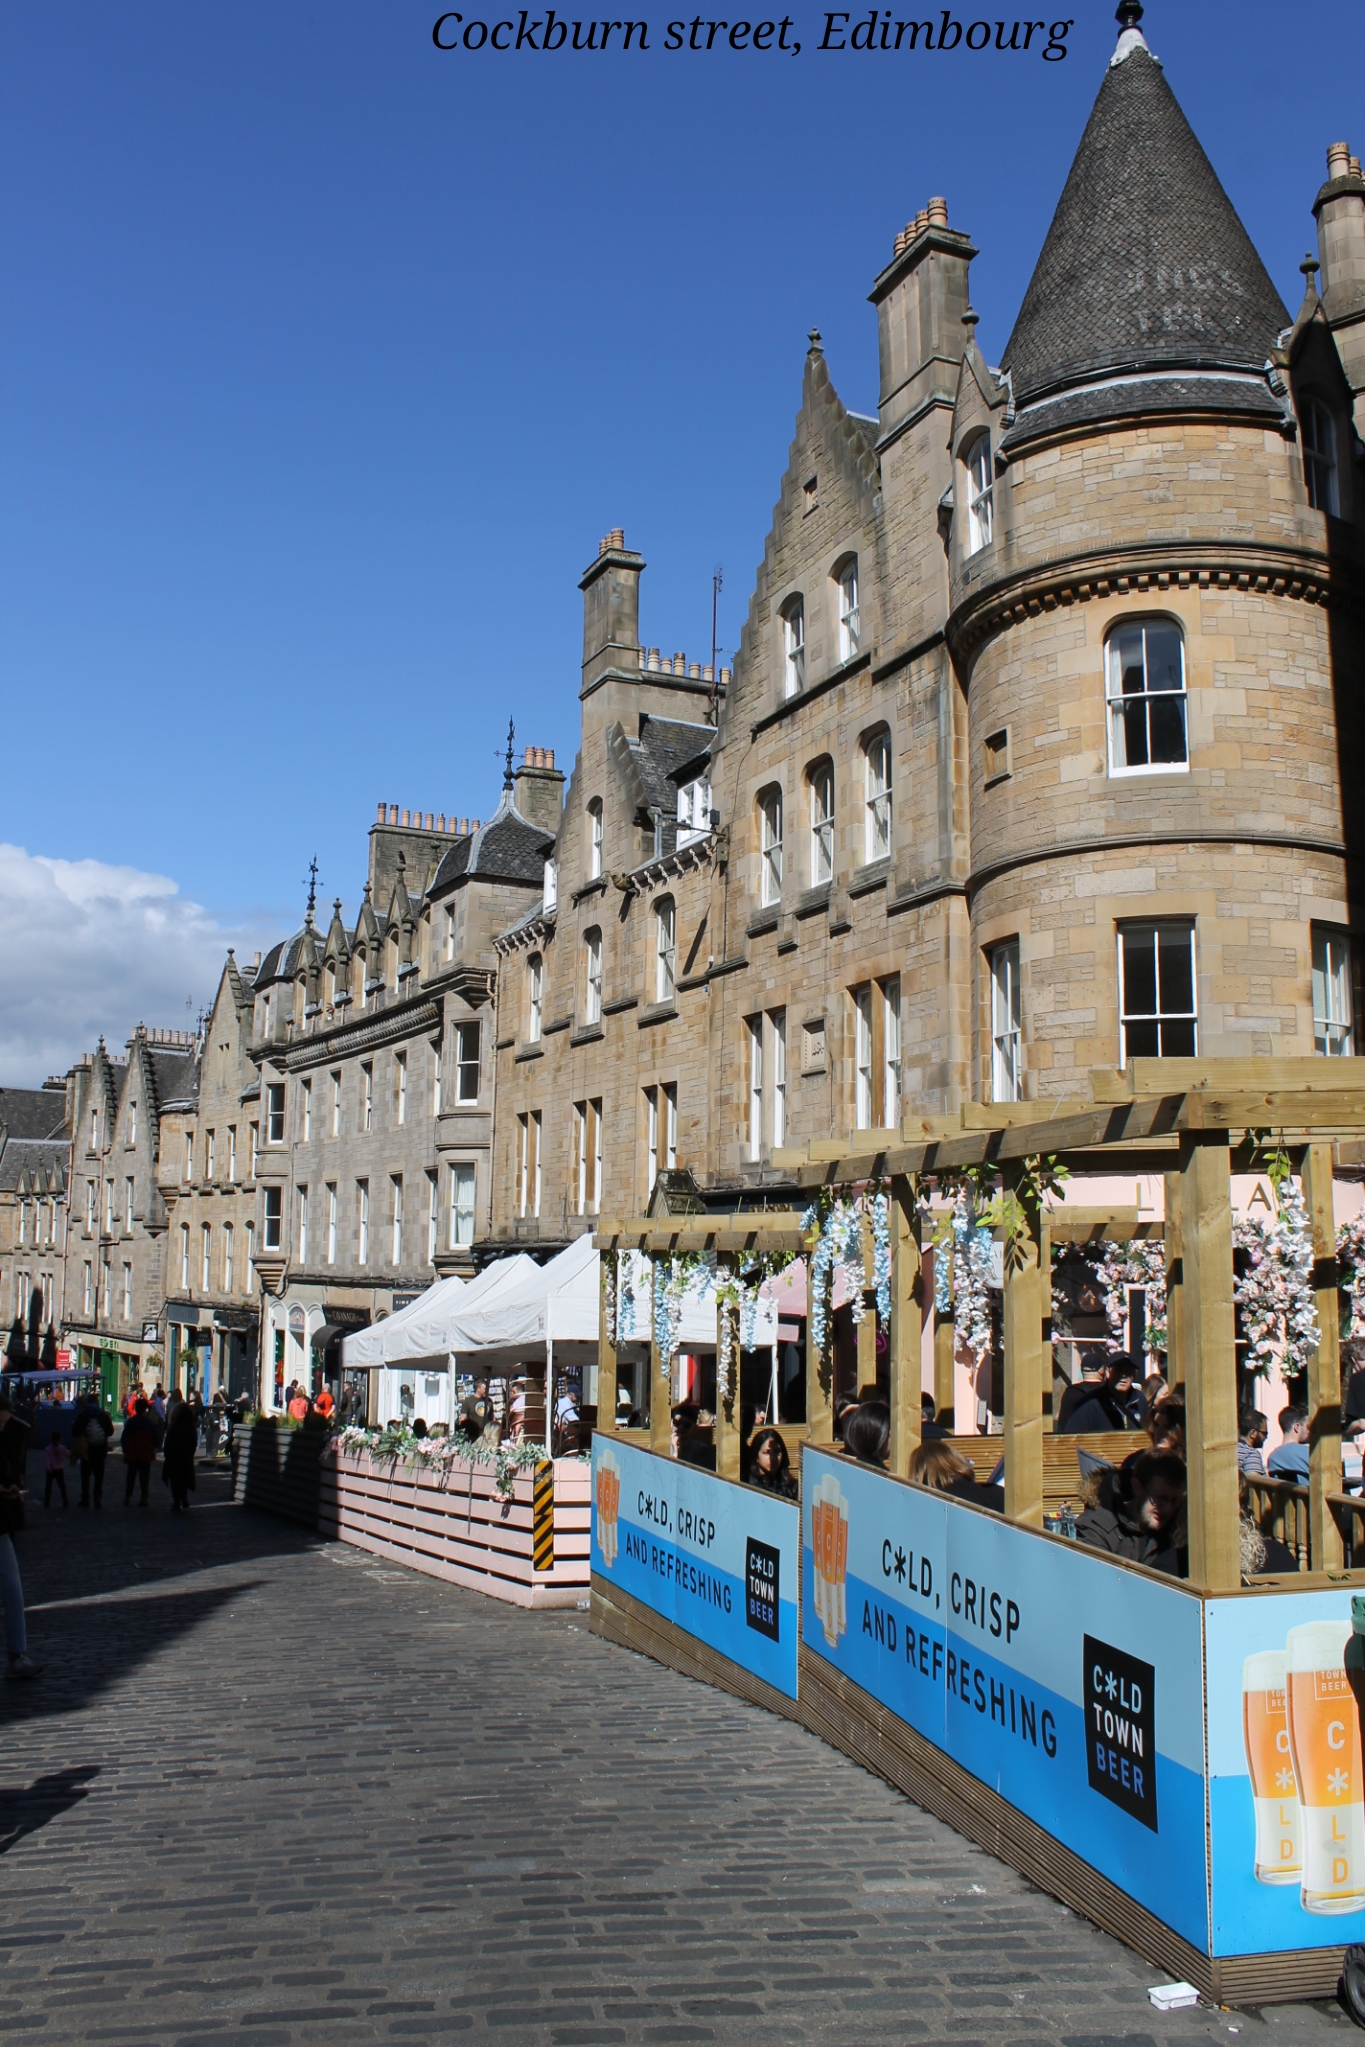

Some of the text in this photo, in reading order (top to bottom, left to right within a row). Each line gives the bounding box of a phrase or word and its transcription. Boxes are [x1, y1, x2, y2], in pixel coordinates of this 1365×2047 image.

[678, 1507, 715, 1548] CRISP
[626, 1532, 732, 1614] AND REFRESHING
[750, 1575, 775, 1603] TOWN
[750, 1600, 774, 1626] BEER
[950, 1571, 1020, 1644] CRISP
[862, 1599, 1058, 1759] AND REFRESHING
[1321, 1681, 1347, 1691] BEER
[1093, 1702, 1144, 1758] TOWN
[1096, 1742, 1145, 1799] BEER
